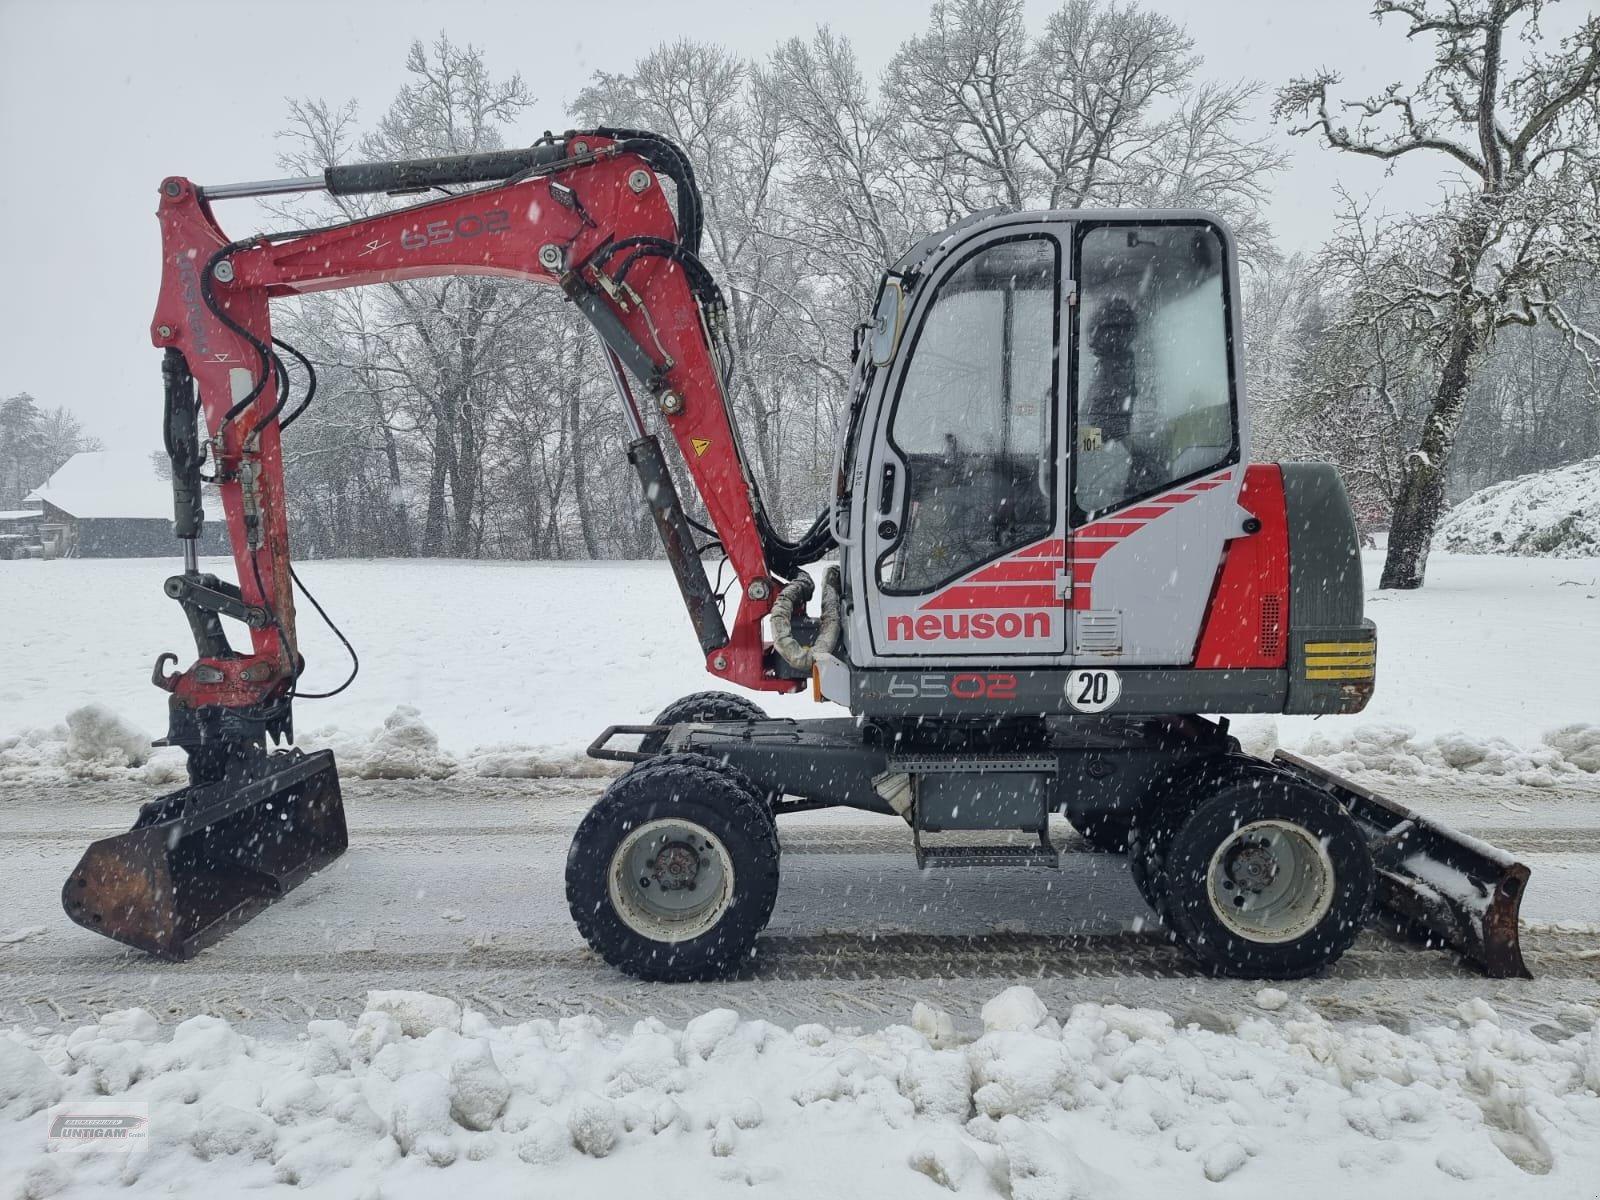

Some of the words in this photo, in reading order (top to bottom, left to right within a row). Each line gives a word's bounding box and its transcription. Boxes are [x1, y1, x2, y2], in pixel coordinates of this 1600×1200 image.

[401, 209, 512, 250] 6502
[887, 611, 1050, 641] neuson
[888, 673, 1018, 699] 6502
[1077, 672, 1109, 705] 20
